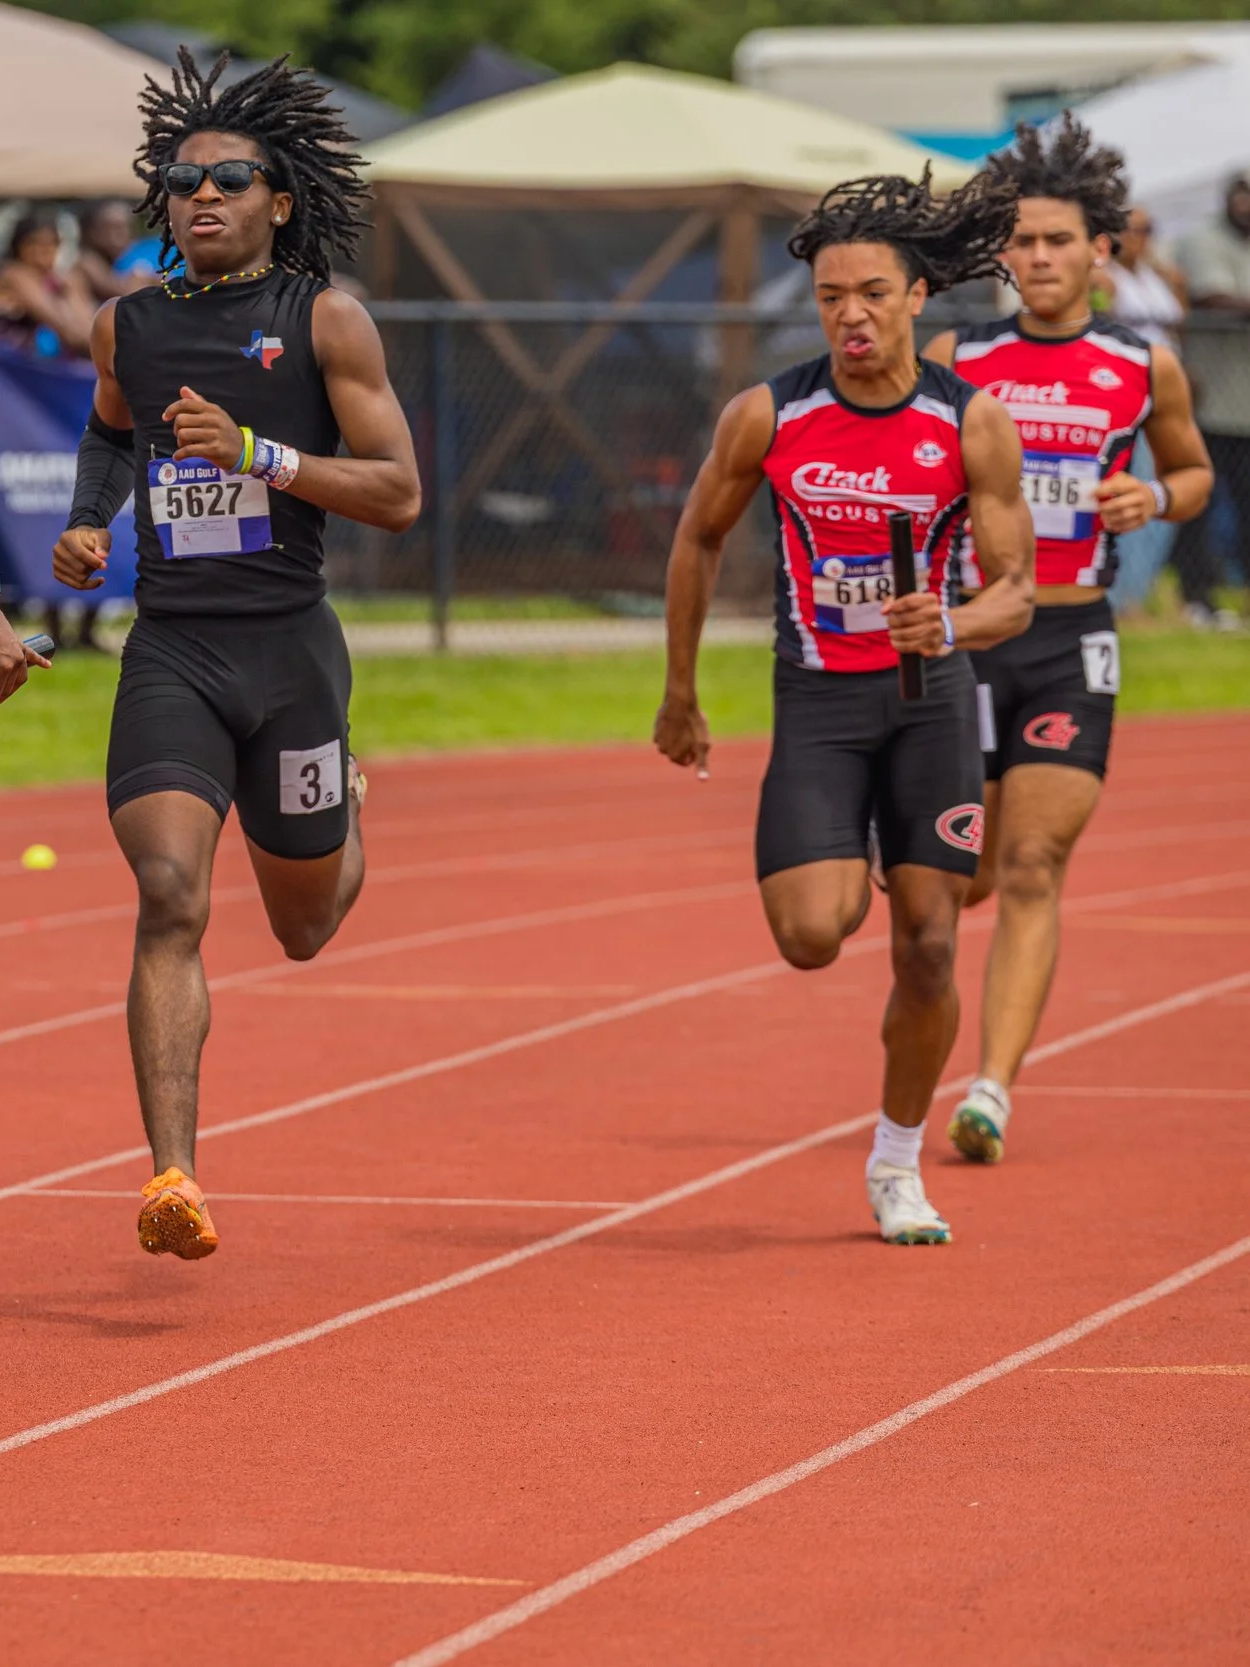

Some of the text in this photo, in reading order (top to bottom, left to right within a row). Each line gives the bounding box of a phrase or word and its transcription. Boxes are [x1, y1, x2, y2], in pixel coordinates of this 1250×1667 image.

[984, 380, 1070, 405] Track
[1018, 421, 1102, 447] USTON
[178, 467, 218, 480] AAU GULF
[792, 461, 892, 493] Track
[166, 482, 243, 519] 5627
[1020, 477, 1079, 505] 196
[807, 504, 932, 525] HOUSN
[1100, 643, 1112, 686] 2
[299, 763, 321, 809] 3
